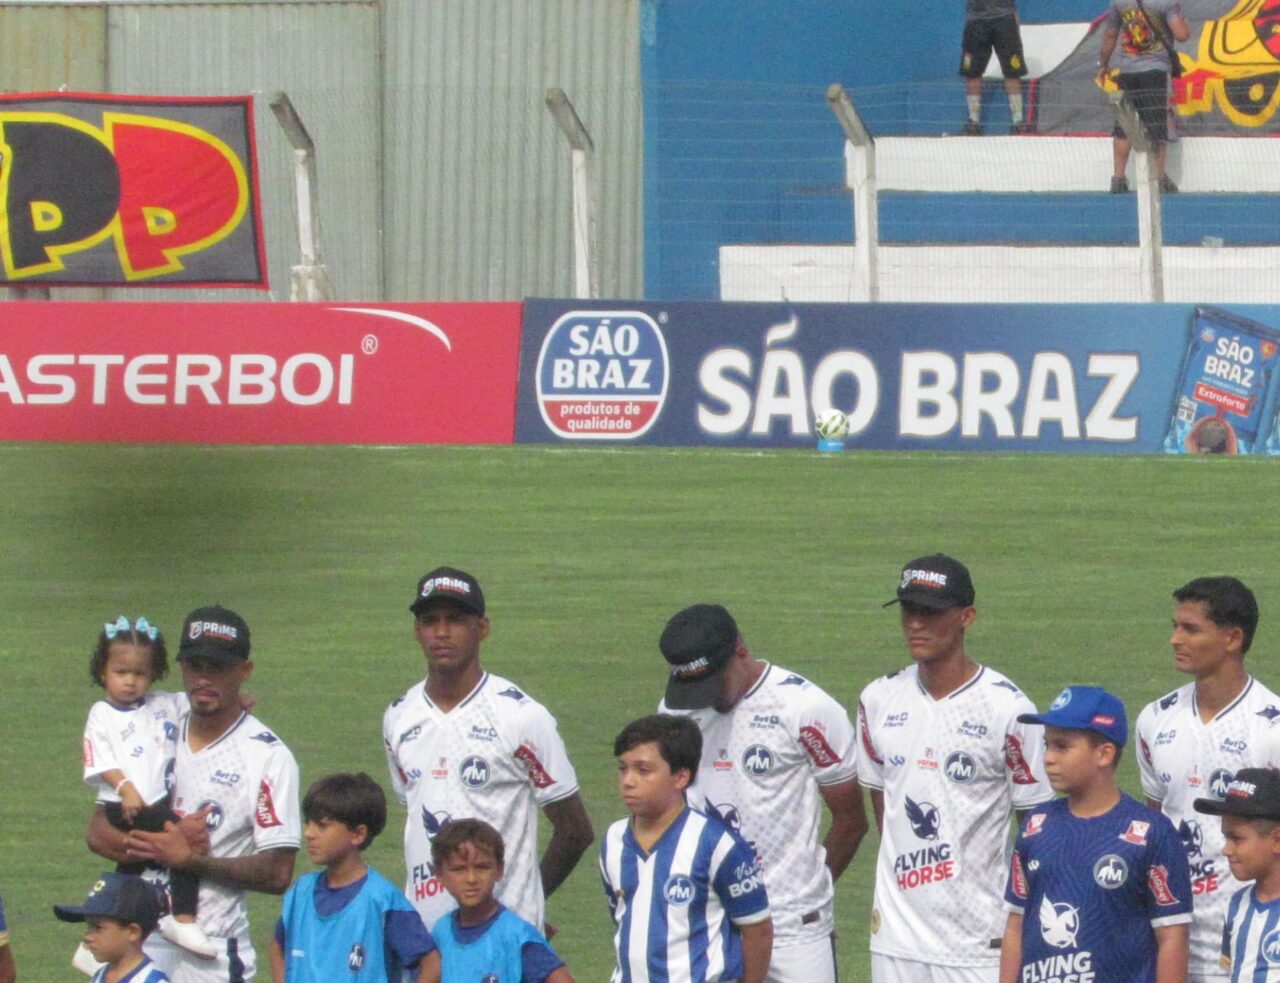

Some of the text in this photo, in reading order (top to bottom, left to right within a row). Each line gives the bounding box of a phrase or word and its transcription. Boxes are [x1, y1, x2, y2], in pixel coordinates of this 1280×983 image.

[552, 359, 653, 389] BRAZ
[1203, 355, 1255, 388] BRAZ
[560, 401, 641, 418] produtos de
[901, 350, 1139, 441] BRAZ
[567, 417, 633, 432] qualidade
[413, 861, 436, 884] FLY
[894, 842, 950, 874] FLYING
[728, 870, 765, 898] BON
[896, 860, 955, 890] HORSE
